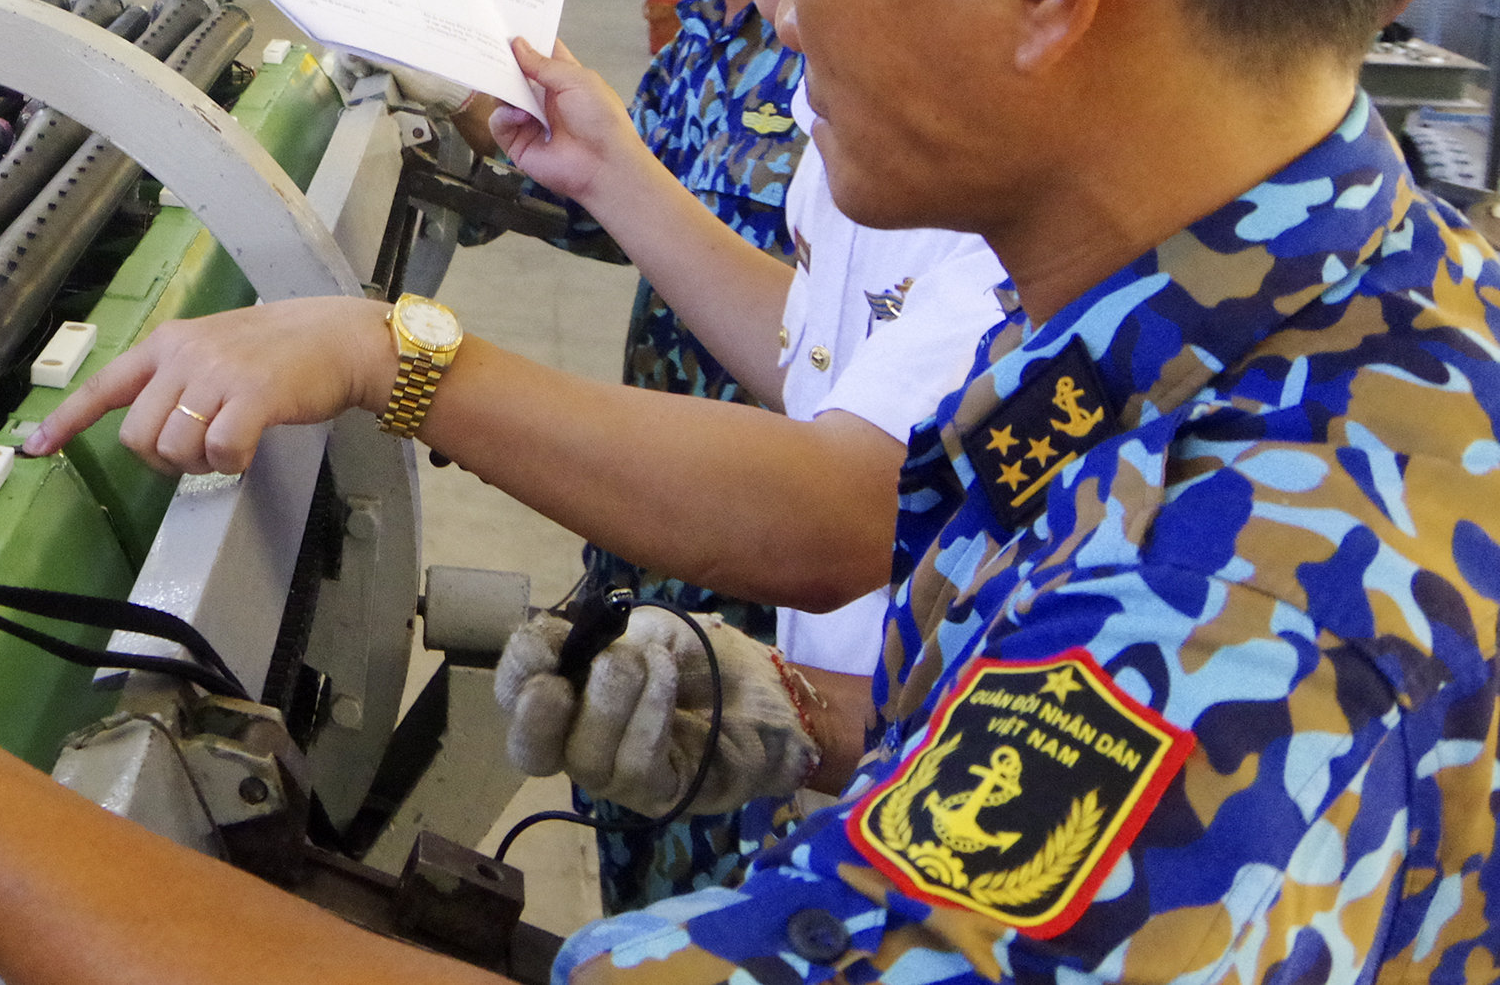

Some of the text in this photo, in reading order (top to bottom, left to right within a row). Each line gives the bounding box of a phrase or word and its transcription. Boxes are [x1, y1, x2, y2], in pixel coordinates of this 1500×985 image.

[969, 688, 1142, 772] QUÂN ĐỘI NHÂN DÂN
[987, 716, 1080, 768] VIỆT NAM
